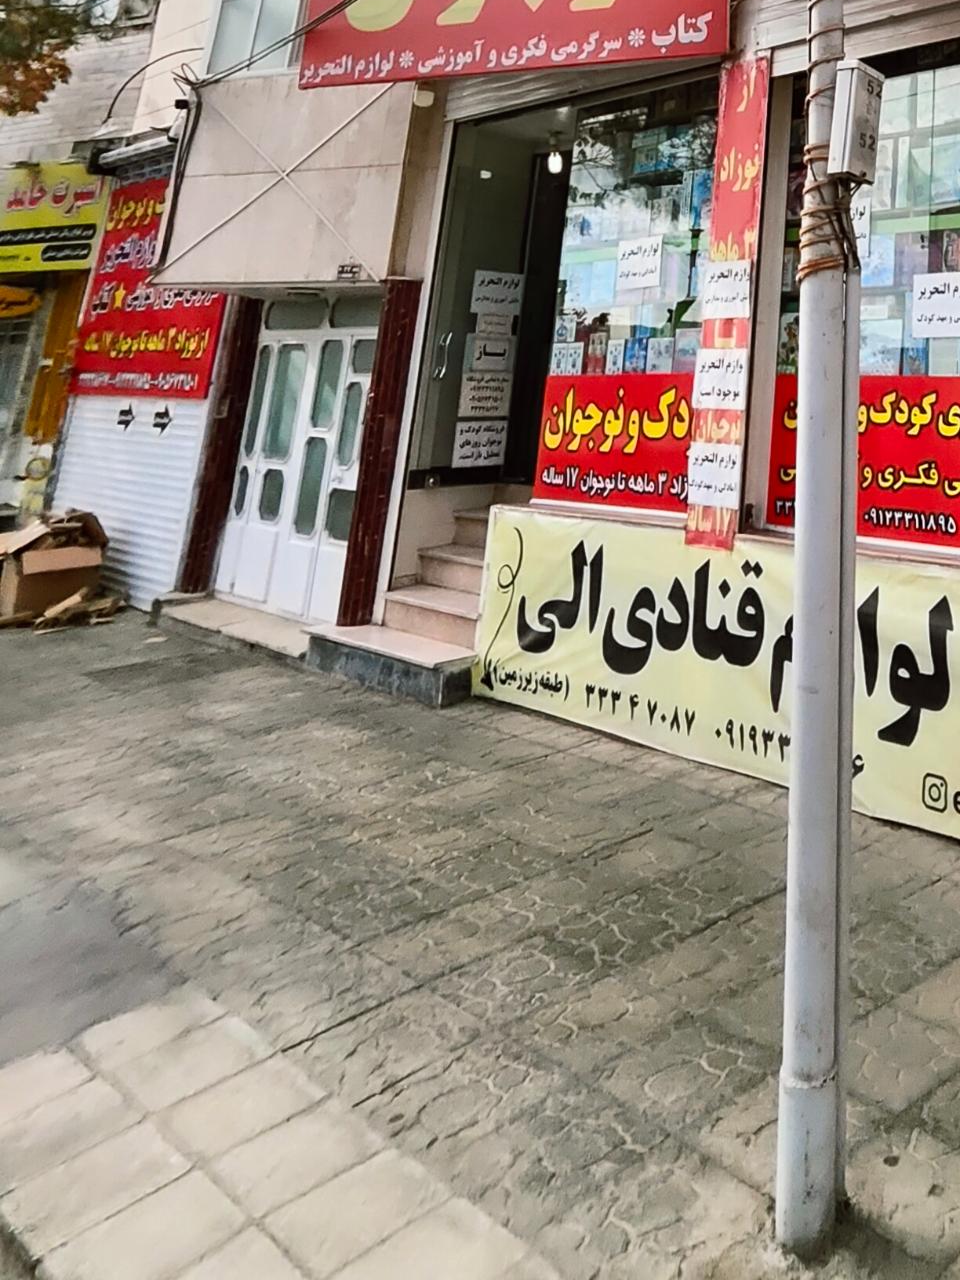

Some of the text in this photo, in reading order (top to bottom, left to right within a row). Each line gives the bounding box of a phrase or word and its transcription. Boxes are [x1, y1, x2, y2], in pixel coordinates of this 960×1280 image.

[300, 11, 713, 84] کتاب سرگرمی فکری و آموزشی لوازم التحریر
[736, 64, 757, 112] از
[866, 78, 882, 101] 52
[859, 132, 876, 151] 52
[720, 143, 760, 192] نوزاد
[733, 268, 751, 282] وازم
[917, 282, 951, 300] التحریر
[476, 344, 507, 361] باز
[725, 358, 744, 373] وازم
[544, 386, 690, 454] دک و نوجوان
[870, 391, 937, 435] کودک
[541, 466, 689, 501] زاد ۳ ماهه تا نوجوان ۱۷ ساله
[862, 467, 873, 488] و
[878, 462, 939, 490] فکری
[864, 506, 958, 534] ۰۹۱۲۳۳۱۱۸۹۵
[516, 539, 604, 654] الی
[602, 559, 765, 675] قنادی
[715, 718, 866, 780] ۰۹۱۹۳۳۶
